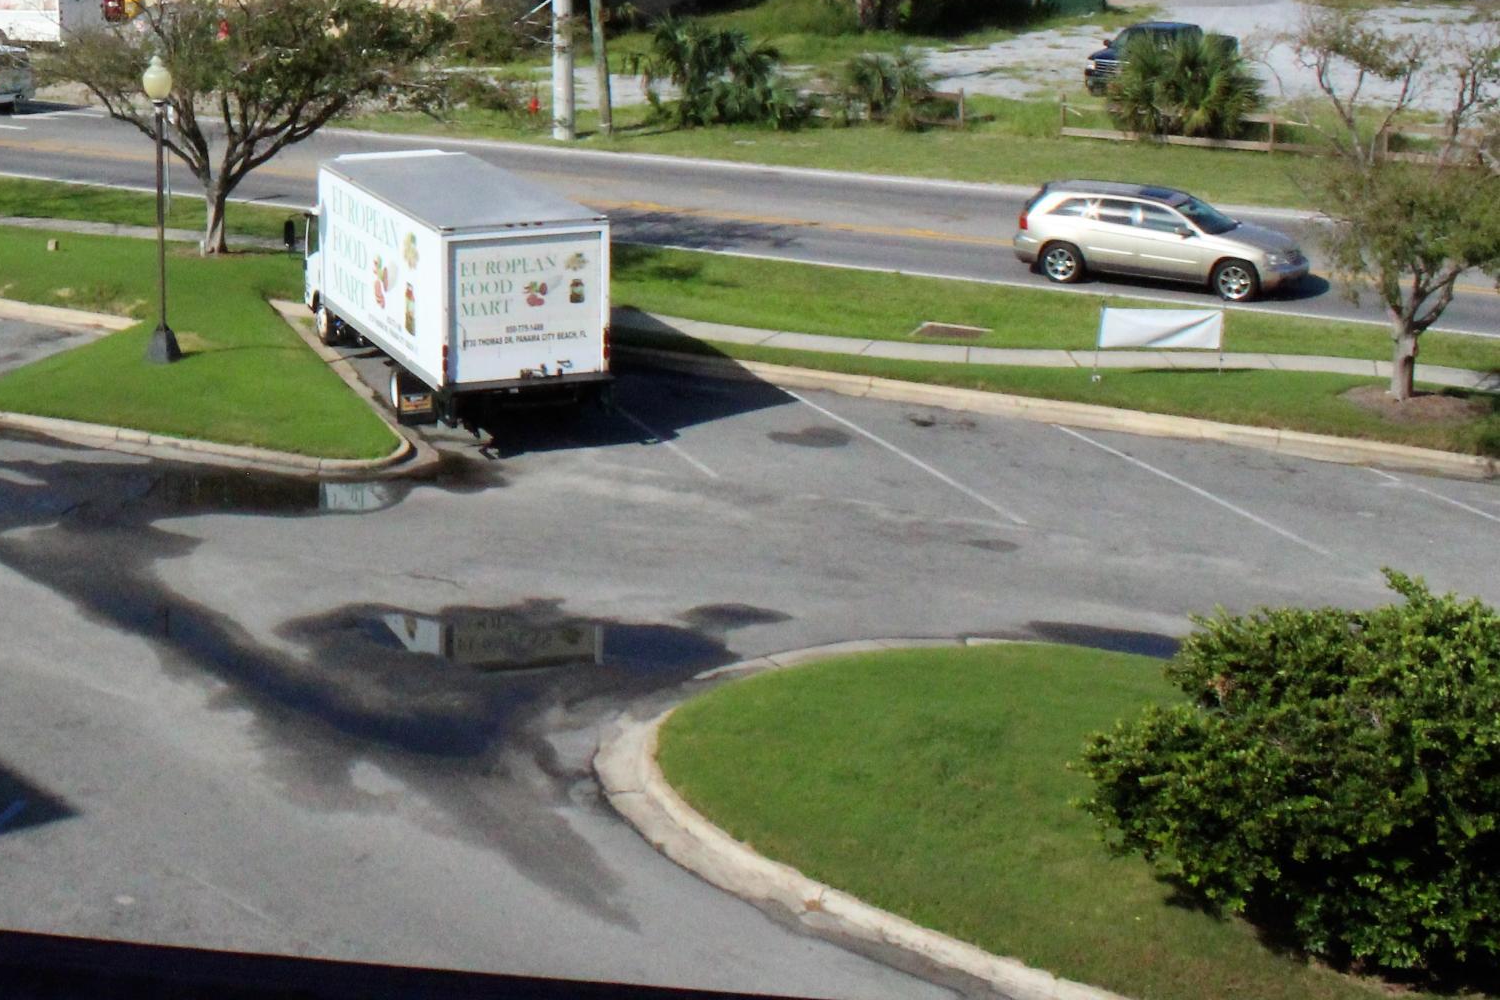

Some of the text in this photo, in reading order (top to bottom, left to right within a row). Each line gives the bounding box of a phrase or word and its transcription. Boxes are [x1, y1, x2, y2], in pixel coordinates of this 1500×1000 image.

[332, 184, 399, 249] EUROPEAN
[332, 223, 368, 271] FOOD
[460, 254, 558, 277] EUROPEAN
[333, 261, 367, 310] MART
[460, 279, 513, 297] FOOD
[460, 299, 513, 317] MART
[516, 333, 540, 342] PANAMA
[542, 332, 555, 341] CITY
